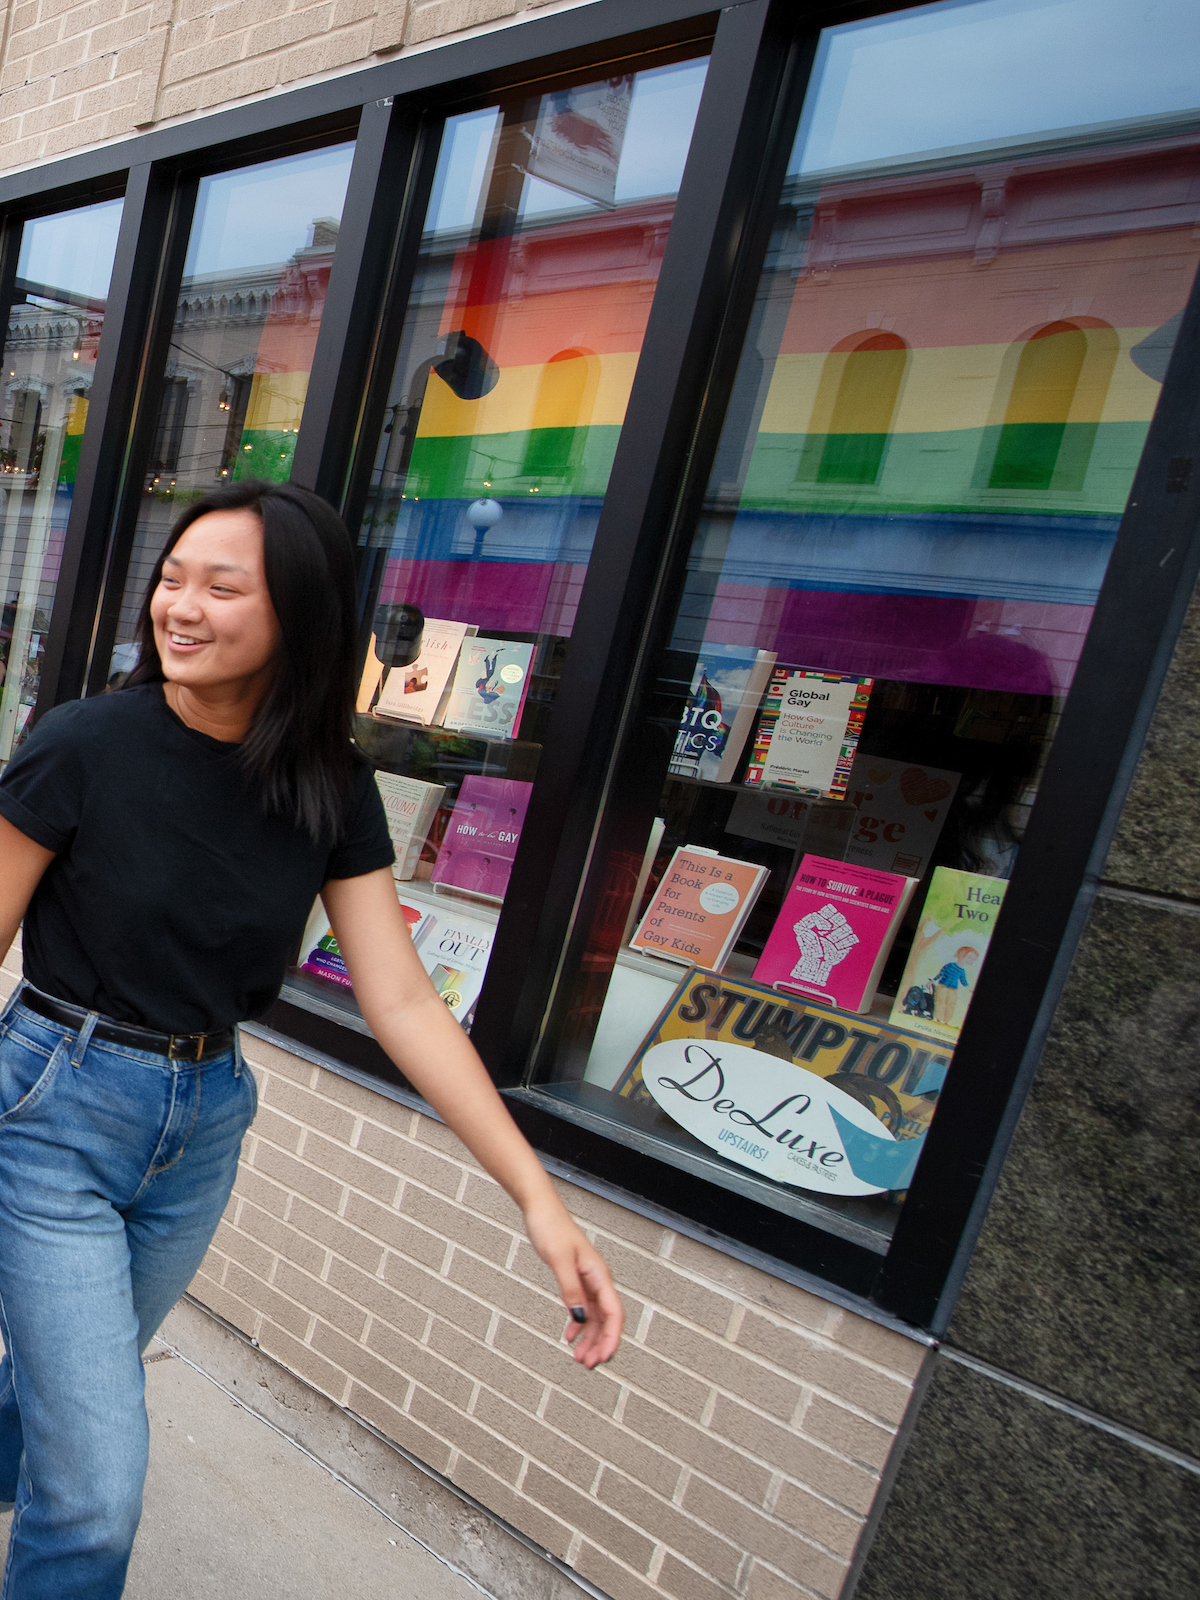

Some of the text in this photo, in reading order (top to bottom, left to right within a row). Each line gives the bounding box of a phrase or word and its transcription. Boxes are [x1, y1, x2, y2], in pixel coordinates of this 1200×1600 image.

[787, 697, 811, 708] Gay
[789, 689, 830, 701] Global
[452, 694, 516, 725] LESS
[783, 713, 825, 725] How Gay
[781, 720, 815, 730] Culture
[789, 726, 833, 741] Changing
[778, 734, 823, 746] the World
[386, 795, 417, 815] COUNTS
[456, 824, 478, 836] HOW
[498, 831, 519, 843] GAY
[680, 859, 733, 881] This Is a
[670, 873, 704, 890] Book
[799, 873, 896, 905] HOW TO SURVIVE A PLAGUE
[663, 888, 682, 900] for
[656, 901, 707, 923] Parents
[954, 903, 989, 922] Two
[650, 917, 665, 928] of
[444, 928, 490, 950] FINALLY
[643, 930, 669, 946] Gay
[671, 938, 702, 955] Kids
[439, 938, 485, 961] OUT
[317, 969, 353, 987] MASON FU
[657, 1044, 845, 1168] DeLuxe
[717, 1128, 770, 1162] UPSTAIRS!
